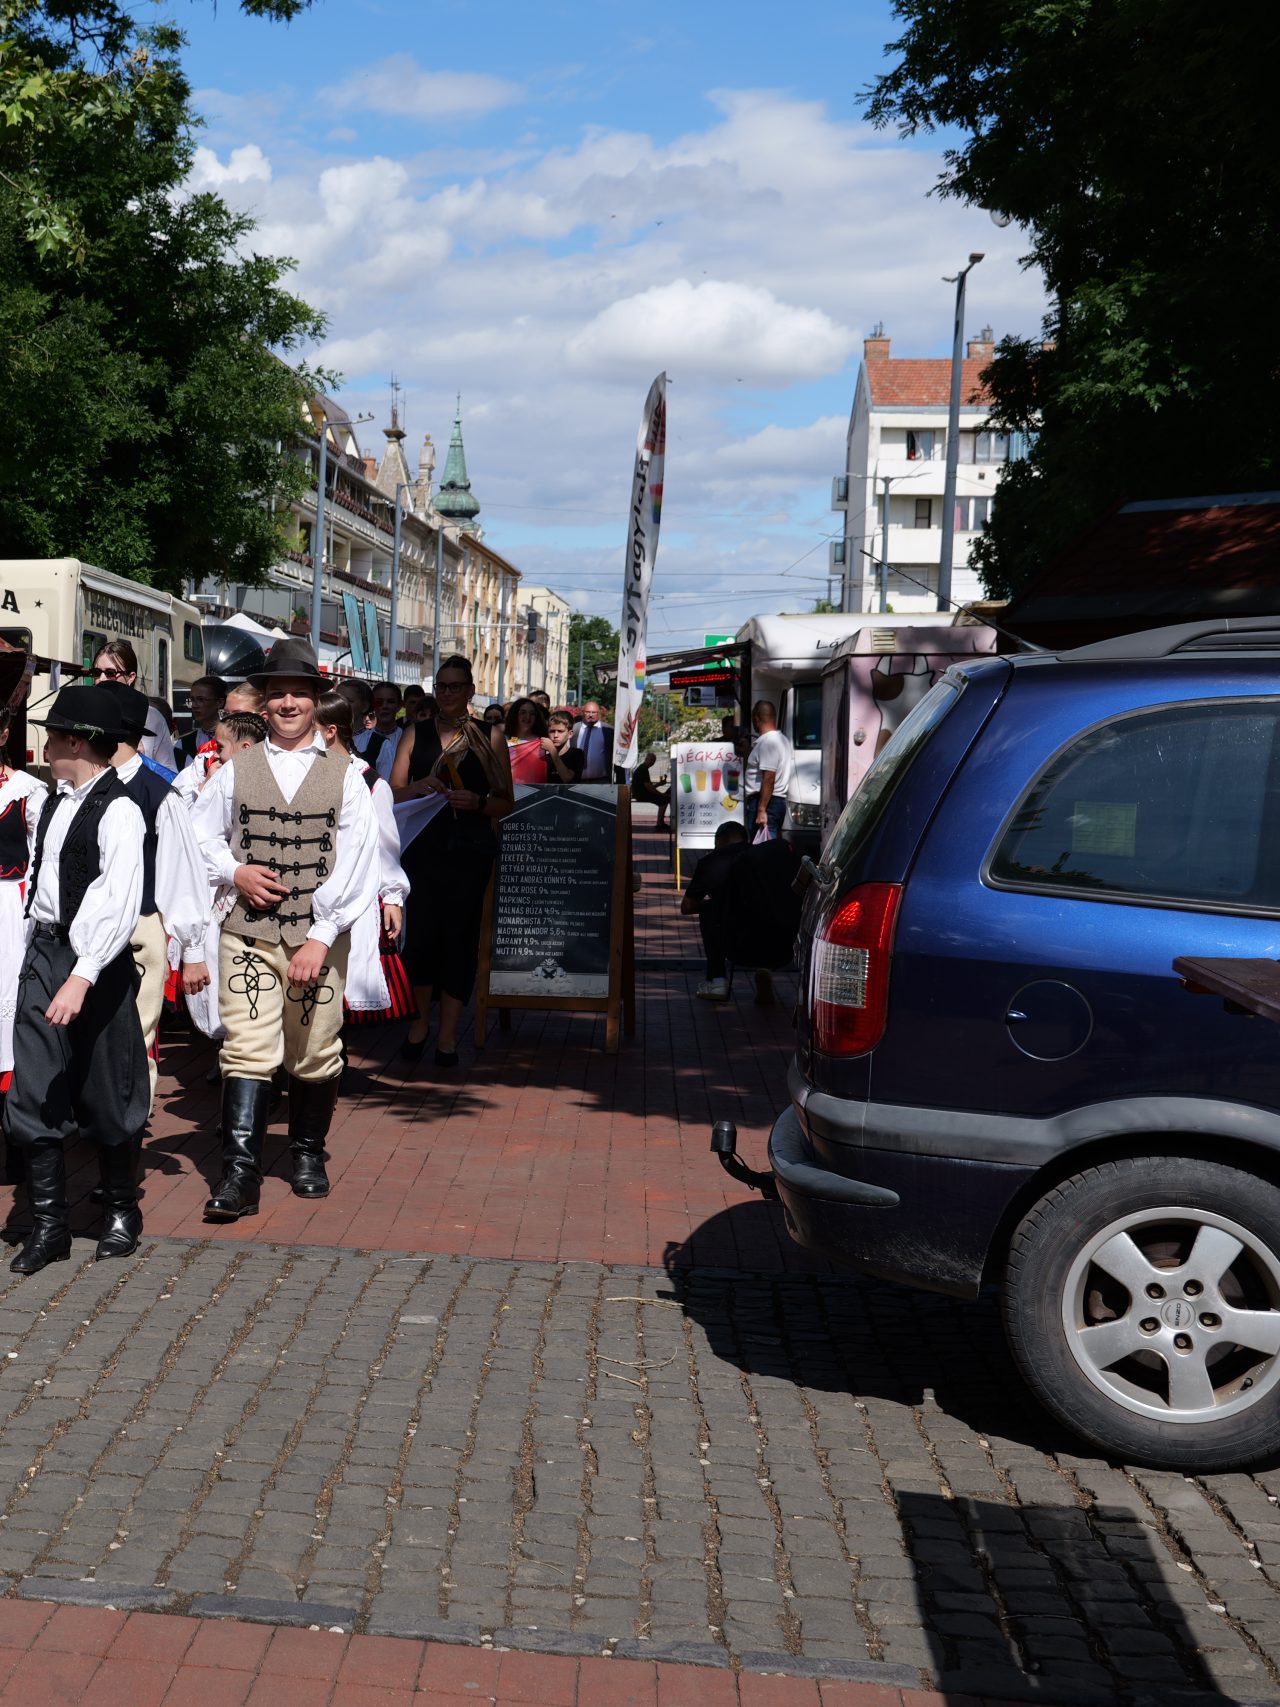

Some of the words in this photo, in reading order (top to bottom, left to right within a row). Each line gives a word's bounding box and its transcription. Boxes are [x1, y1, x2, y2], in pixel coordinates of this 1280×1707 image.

[678, 748, 742, 764] JÉGKÁSA
[526, 863, 548, 873] KIRÁLY
[520, 874, 542, 882] ANDRÁS
[499, 886, 519, 894] BLACK
[521, 886, 537, 894] ROSE
[499, 896, 530, 904] NAPKINCS
[526, 905, 542, 914] BÚZA
[498, 917, 540, 925] MONARCHISTA
[497, 927, 523, 935] MAGYAR
[524, 926, 548, 935] VÁNDOR
